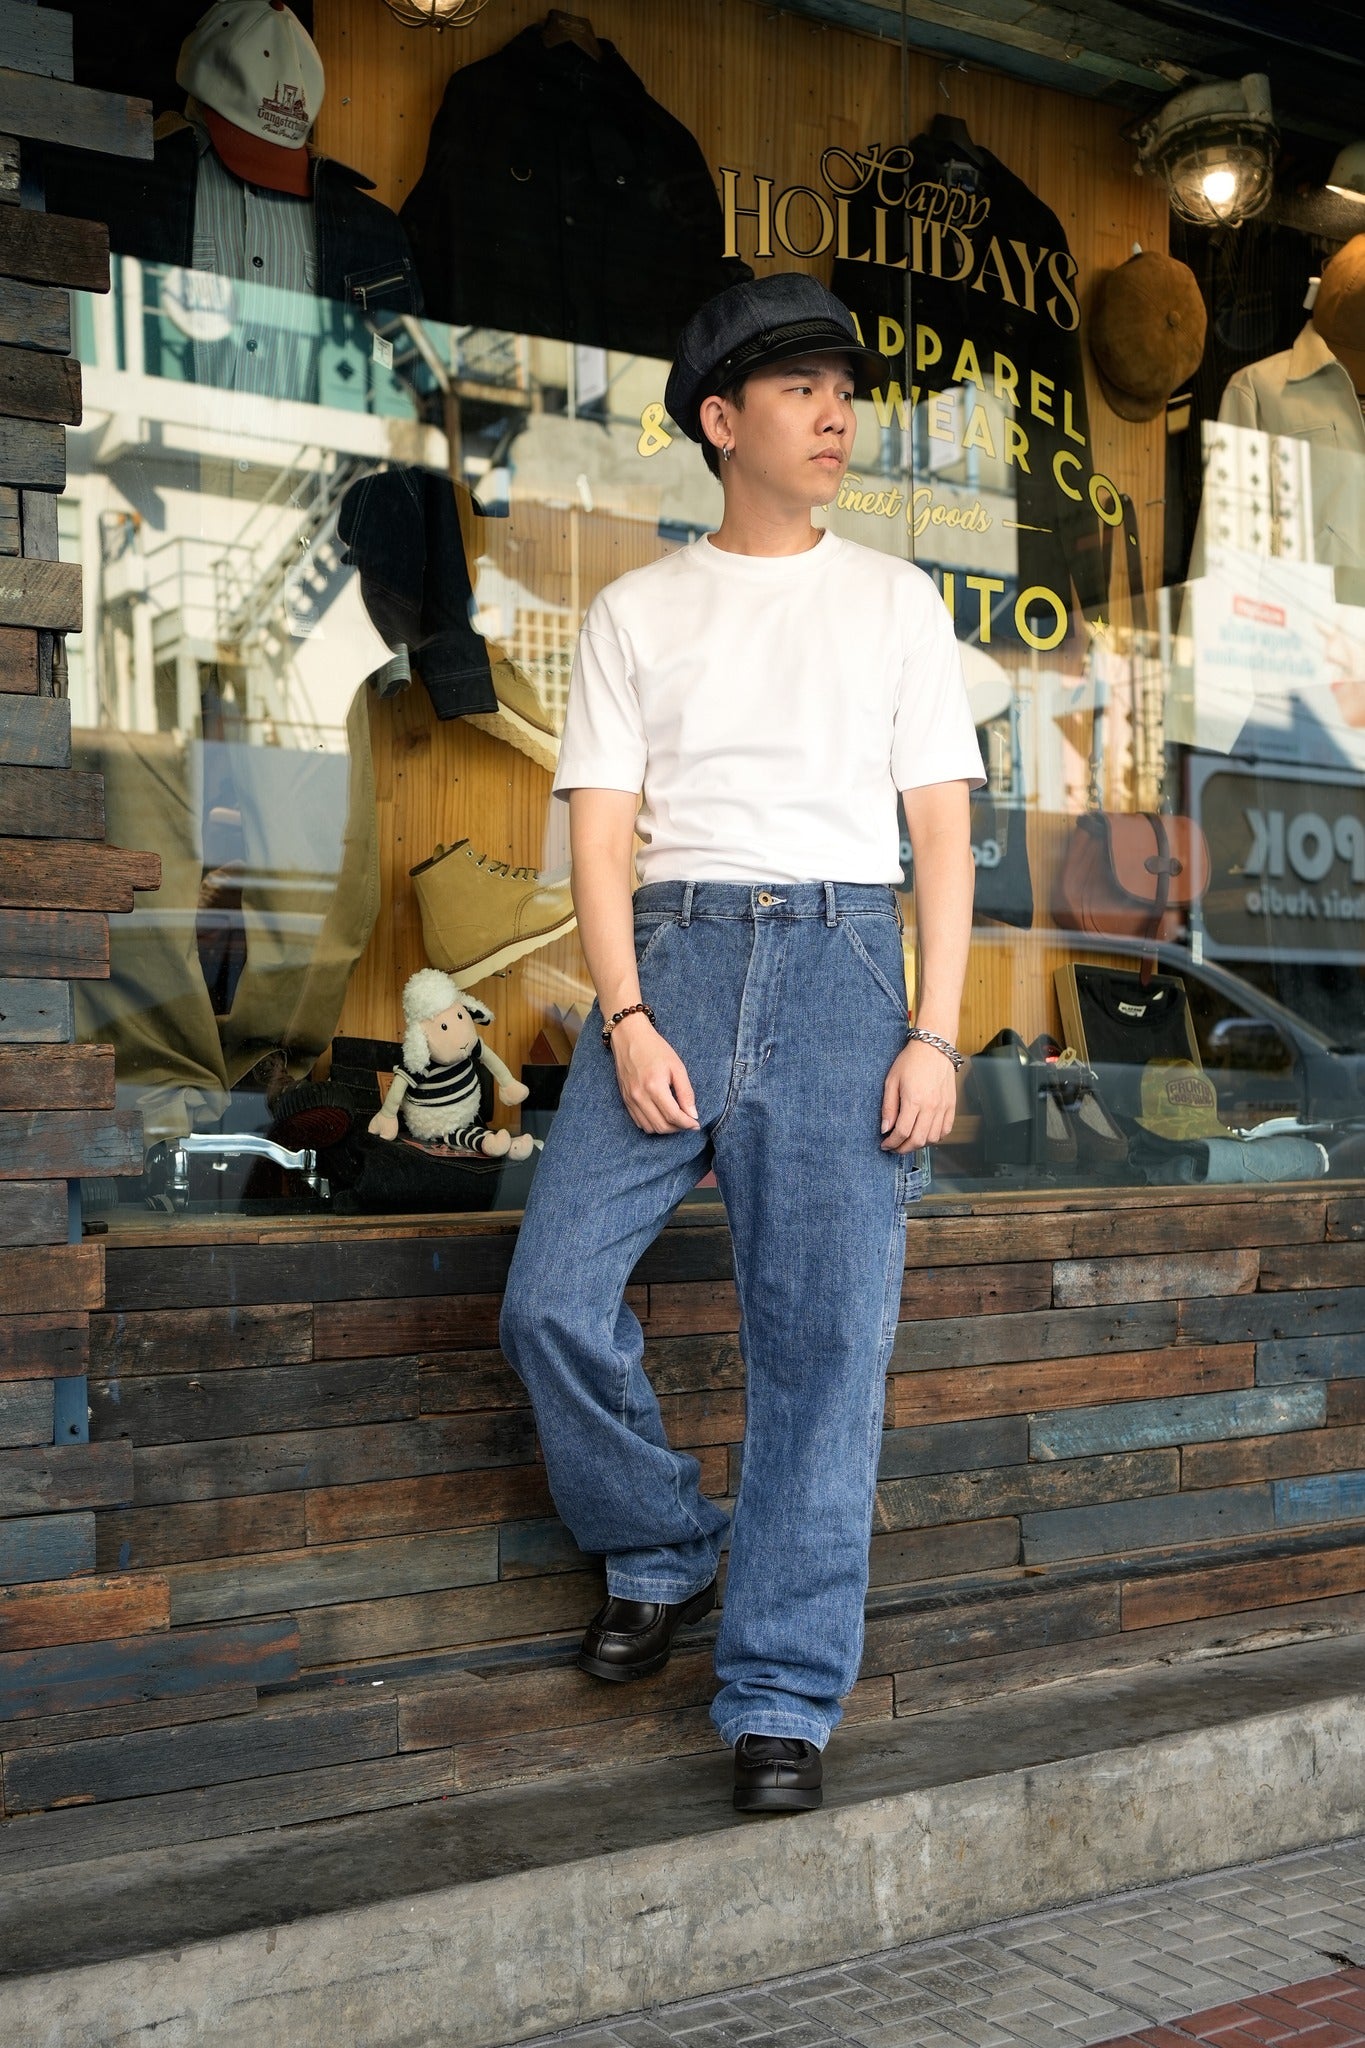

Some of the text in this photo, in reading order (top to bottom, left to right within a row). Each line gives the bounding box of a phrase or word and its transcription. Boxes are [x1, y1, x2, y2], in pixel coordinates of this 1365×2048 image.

[821, 144, 991, 238] Happy
[719, 168, 1081, 332] HOLLIDAYS
[637, 402, 673, 457] &
[1052, 450, 1124, 527] CO
[906, 487, 993, 537] Goods
